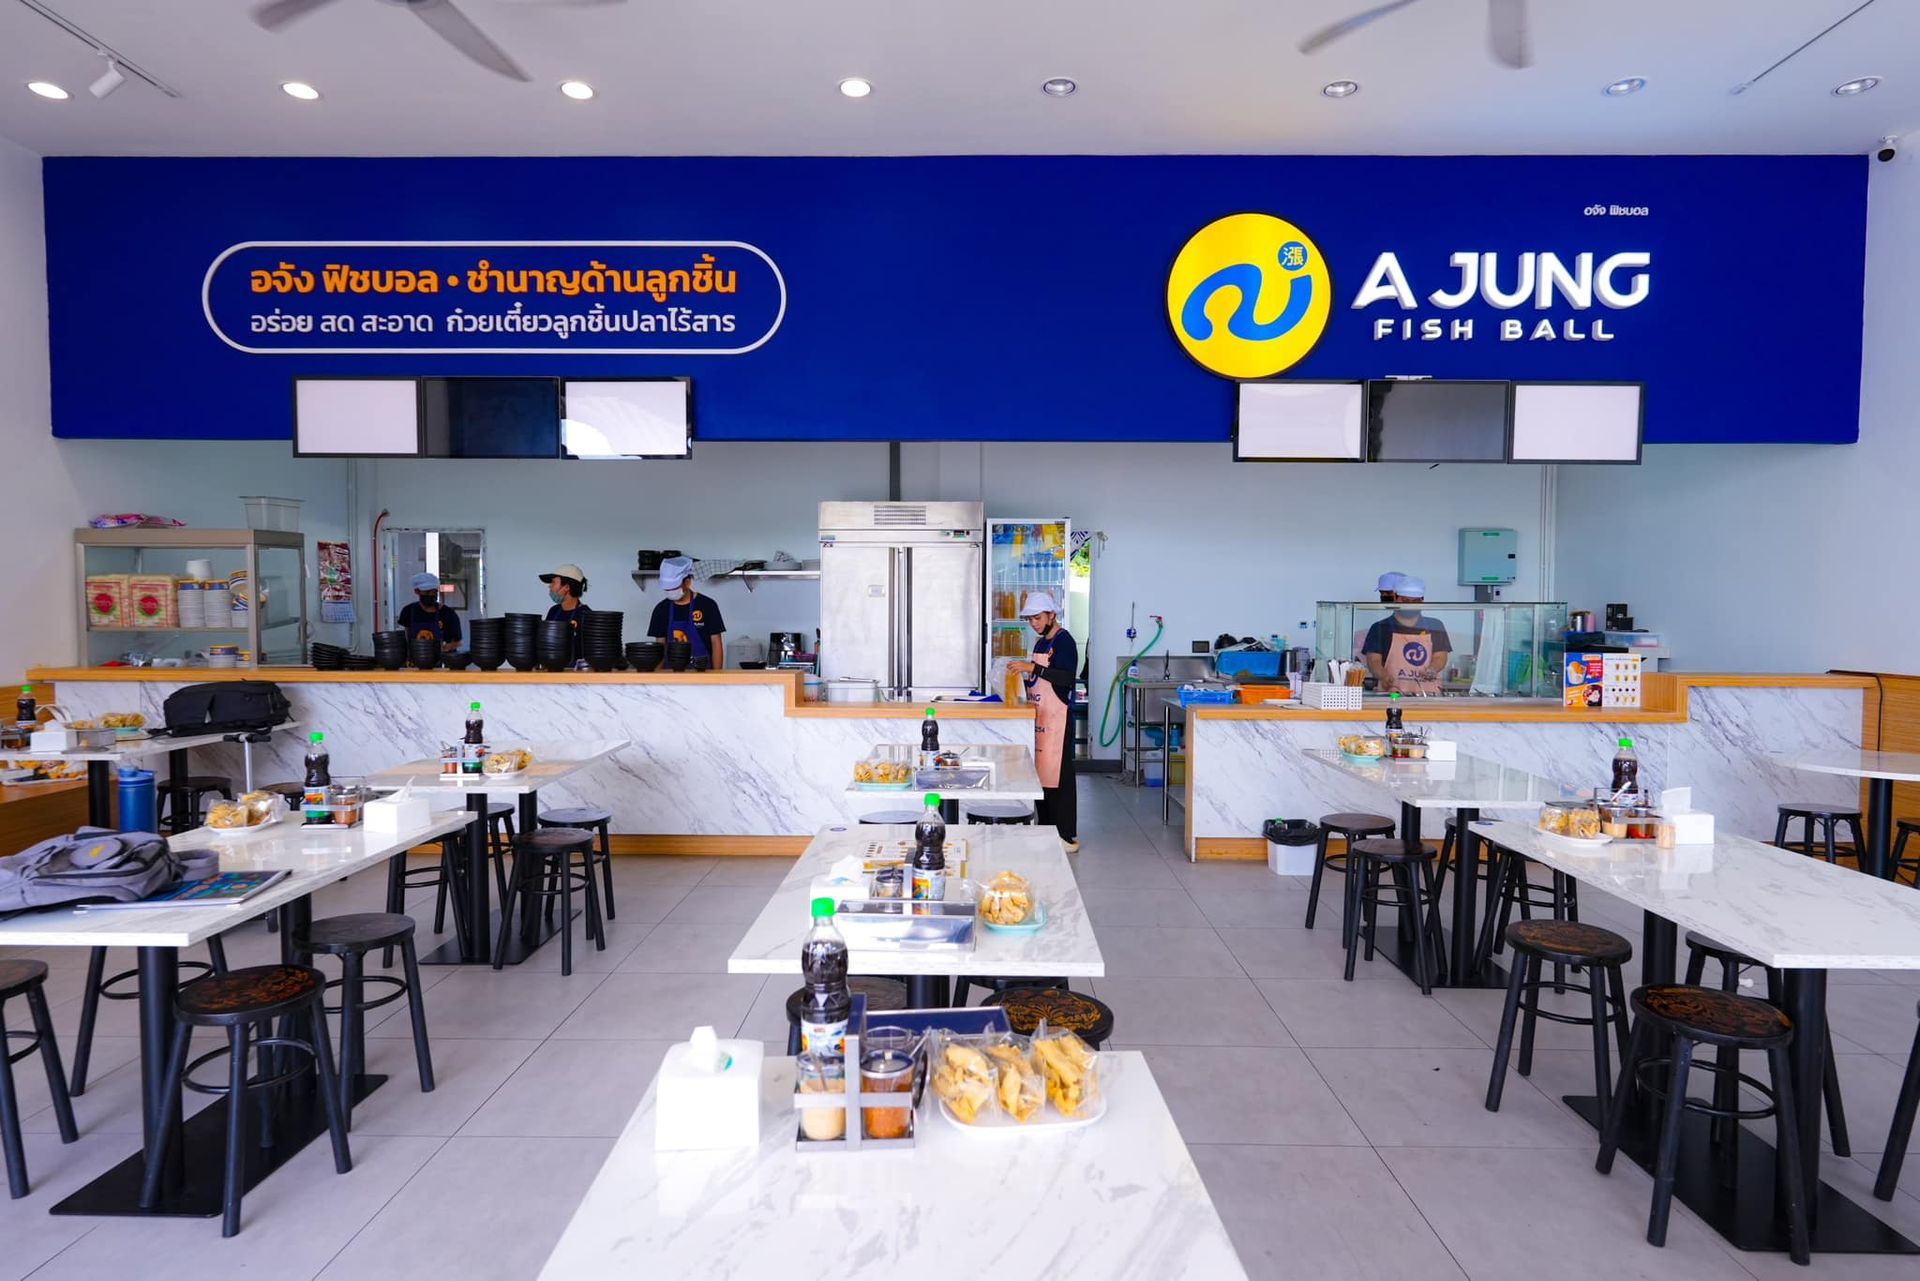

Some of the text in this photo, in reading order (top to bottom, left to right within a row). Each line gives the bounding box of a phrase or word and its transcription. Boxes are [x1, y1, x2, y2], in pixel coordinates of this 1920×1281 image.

[1583, 204, 1607, 216] อจัง
[250, 253, 736, 303] อจัง ฟิชบอล ชำนาญด้านลูกชิ้น
[1351, 251, 1651, 311] A JUNG
[250, 301, 736, 340] อร่อย สด สะอาด ก๋วยเตี๋ยวลูกชิ้นปลาไร้สาร
[1373, 318, 1616, 342] FISH BALL
